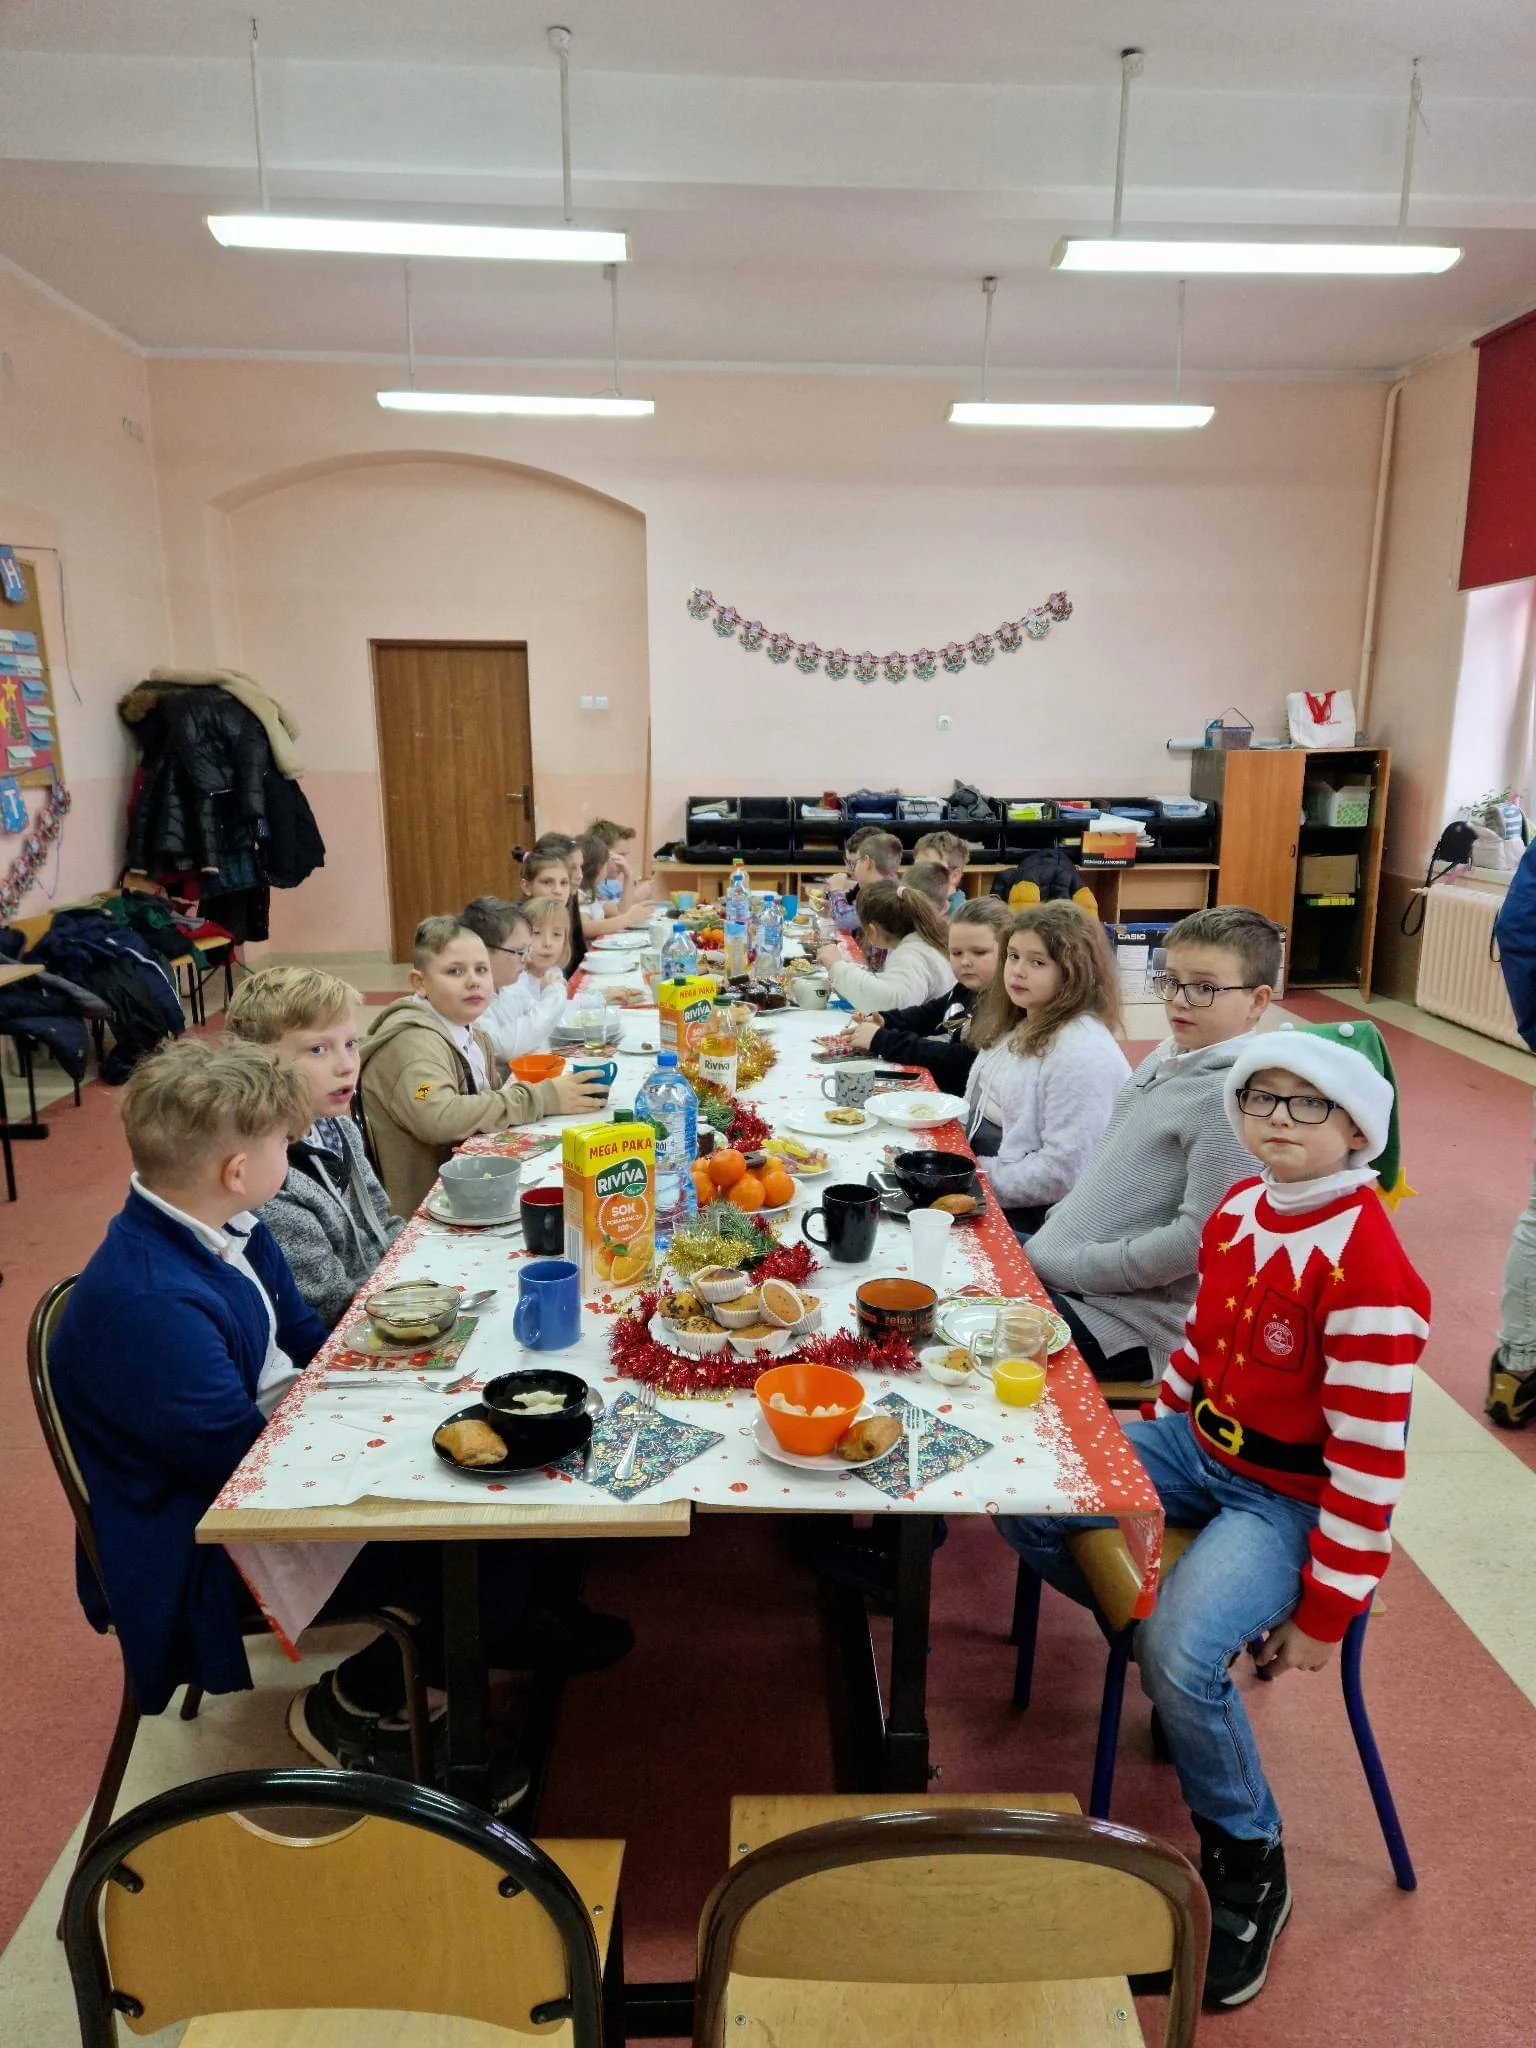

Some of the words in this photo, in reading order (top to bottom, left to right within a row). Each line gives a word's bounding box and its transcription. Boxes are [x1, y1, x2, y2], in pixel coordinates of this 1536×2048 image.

[4, 789, 20, 820] T
[590, 1143, 618, 1159] MEGA
[622, 1137, 653, 1152] PAKA
[611, 1202, 636, 1217] SOK
[884, 1314, 913, 1325] relax
